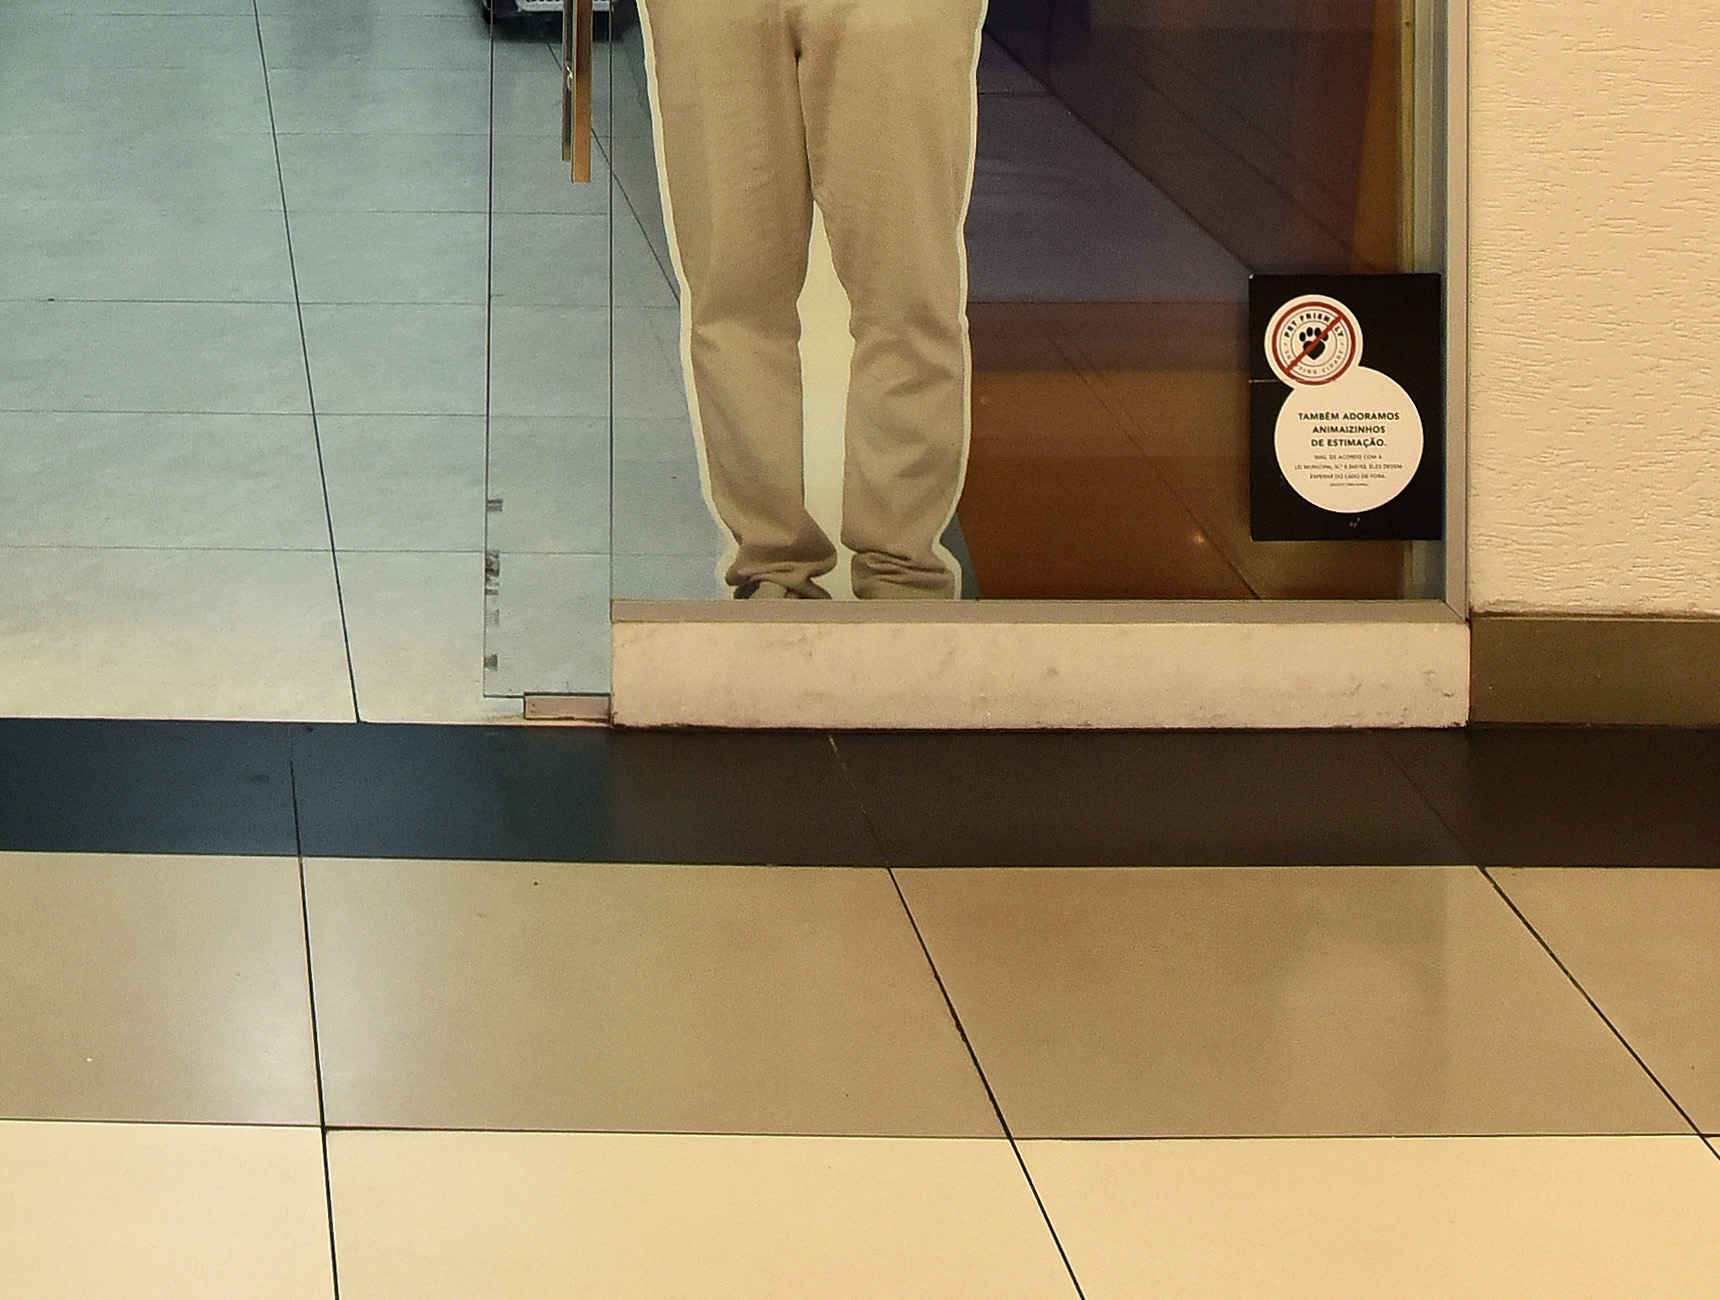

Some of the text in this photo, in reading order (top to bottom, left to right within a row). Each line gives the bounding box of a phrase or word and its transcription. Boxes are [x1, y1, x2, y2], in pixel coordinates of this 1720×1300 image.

[1284, 312, 1345, 338] PET FRIENLY
[1299, 411, 1400, 421] TAMBÉM ADORAMOS
[1312, 425, 1386, 434] ANIMAIZINHOS
[1311, 437, 1387, 449] DE ESTIMAÇÃO.
